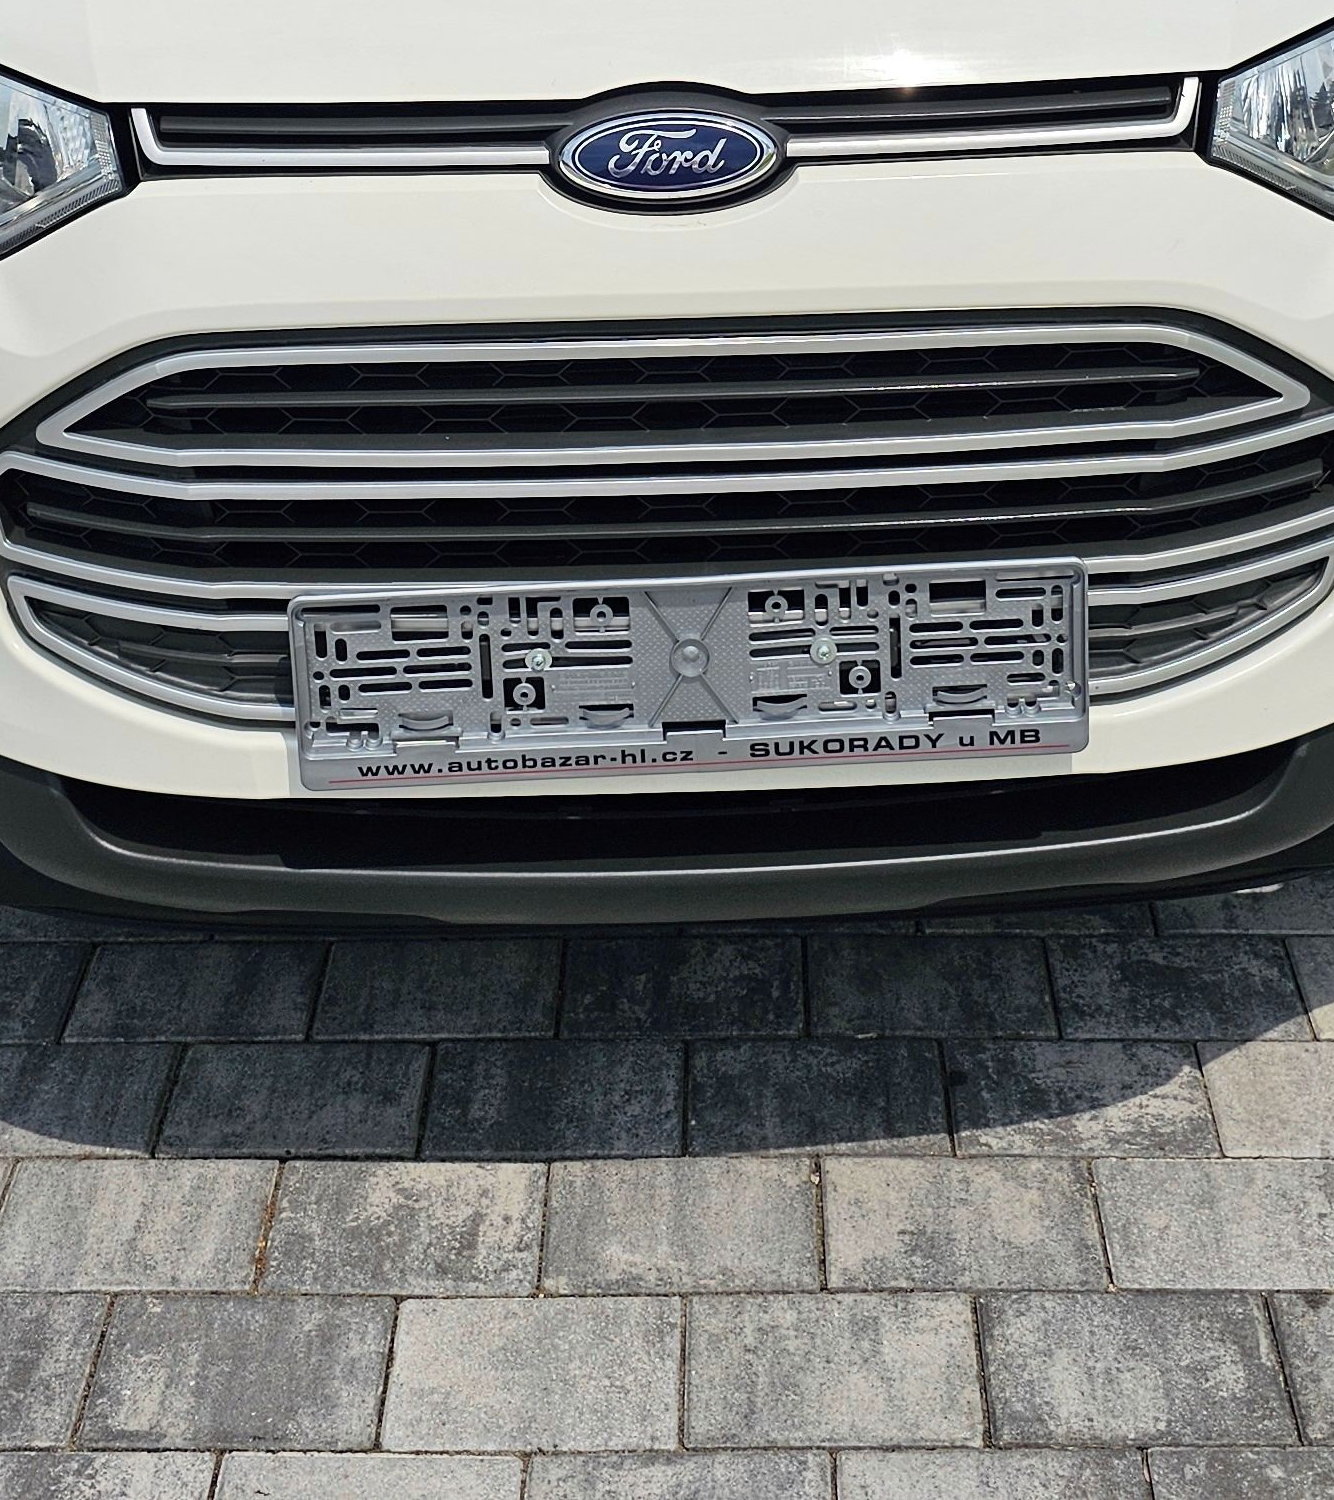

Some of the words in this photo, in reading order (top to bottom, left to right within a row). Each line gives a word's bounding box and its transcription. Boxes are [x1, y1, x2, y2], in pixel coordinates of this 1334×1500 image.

[607, 127, 728, 179] Ford
[357, 748, 695, 778] www.autobazar-hl.cz
[748, 732, 945, 759] SUKORADY
[958, 734, 976, 748] u
[988, 727, 1043, 747] MB
